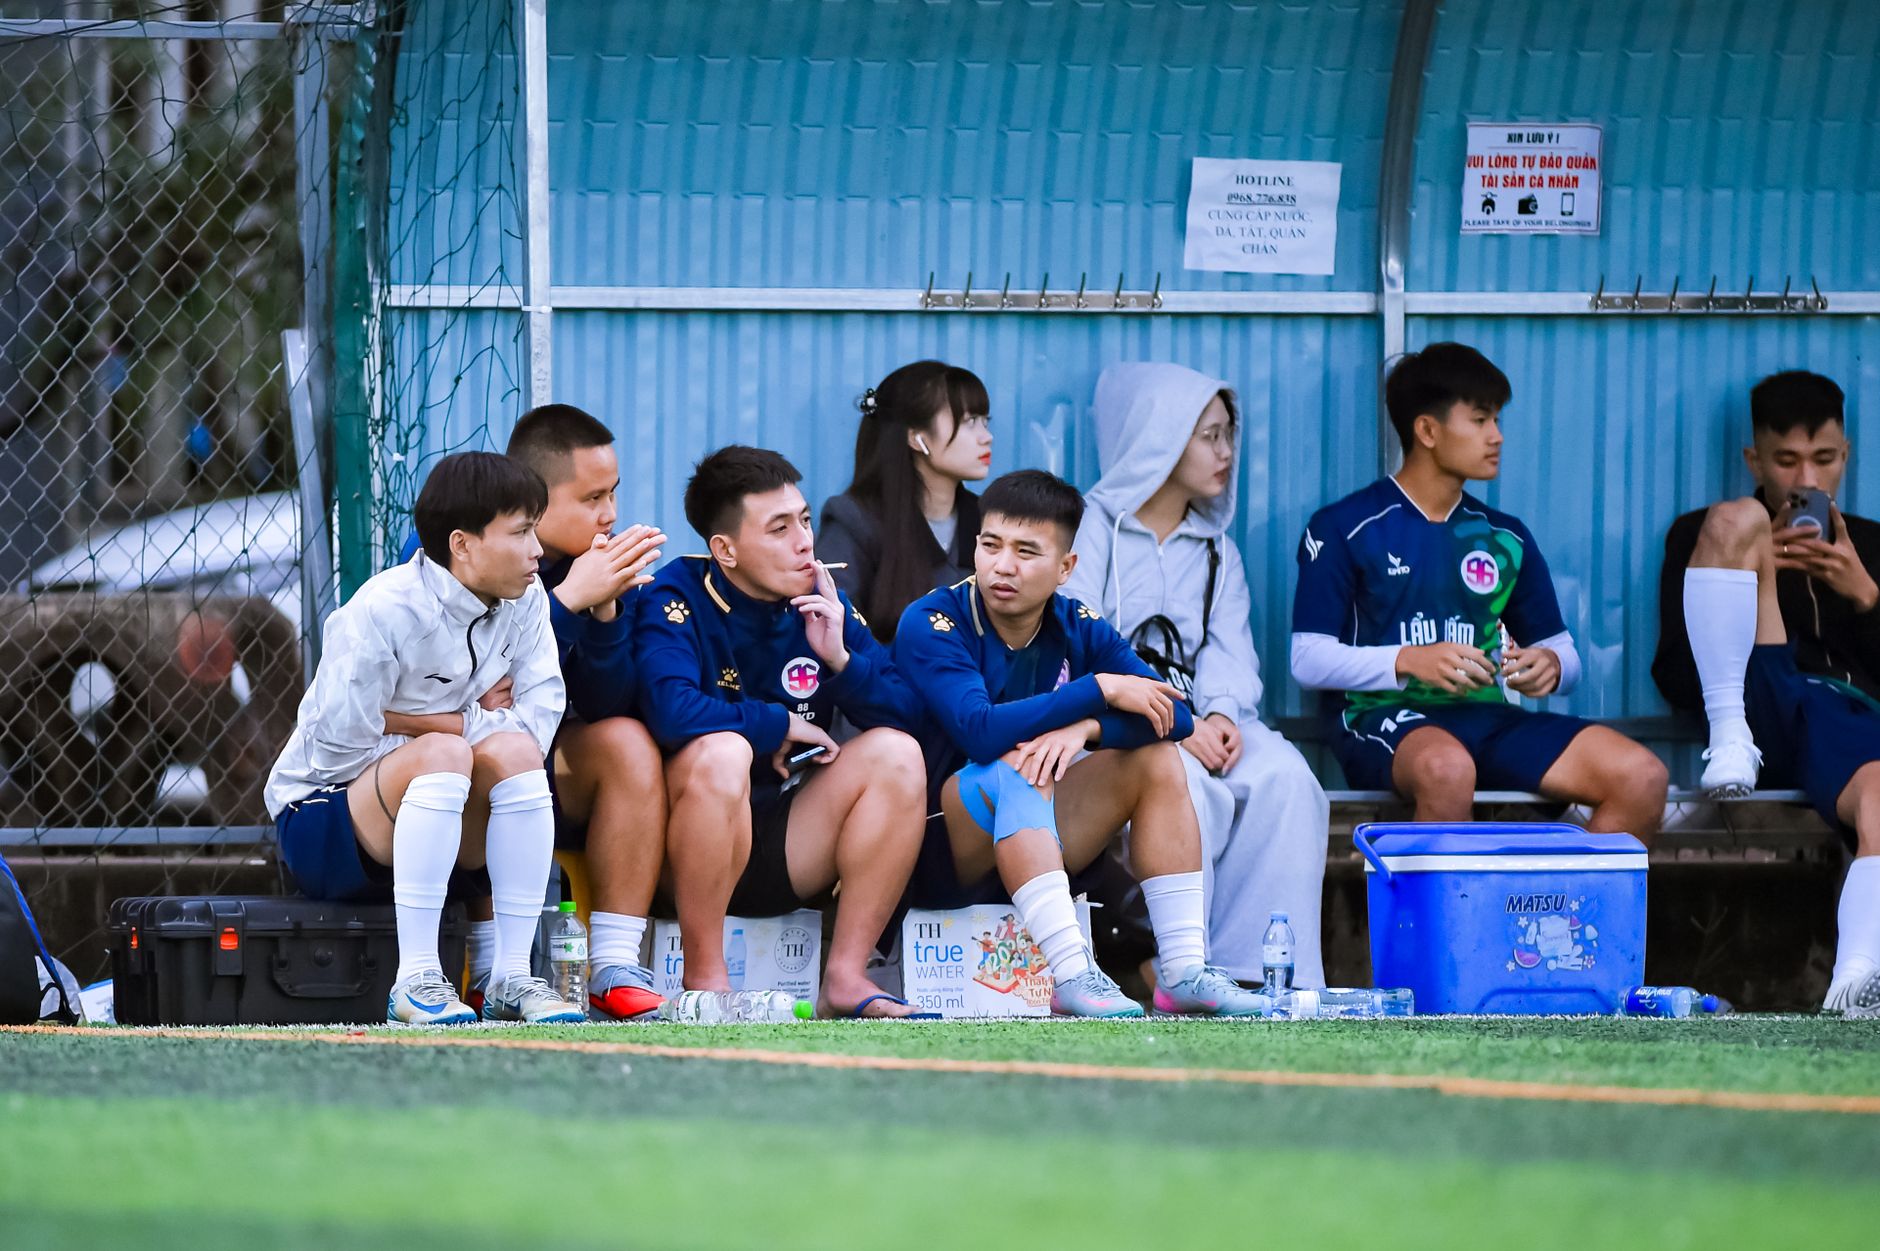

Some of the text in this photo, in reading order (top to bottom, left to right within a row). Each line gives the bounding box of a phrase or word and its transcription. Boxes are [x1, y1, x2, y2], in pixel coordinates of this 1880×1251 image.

[1507, 132, 1523, 143] XIN
[1488, 151, 1517, 168] LÒNG
[1235, 174, 1294, 187] HOTLINE
[1208, 209, 1243, 221] CUNG
[1506, 894, 1568, 913] MATSU
[914, 923, 941, 939] TH
[914, 941, 964, 963] true
[915, 965, 965, 980] WATER
[916, 994, 965, 1009] 350 ml
